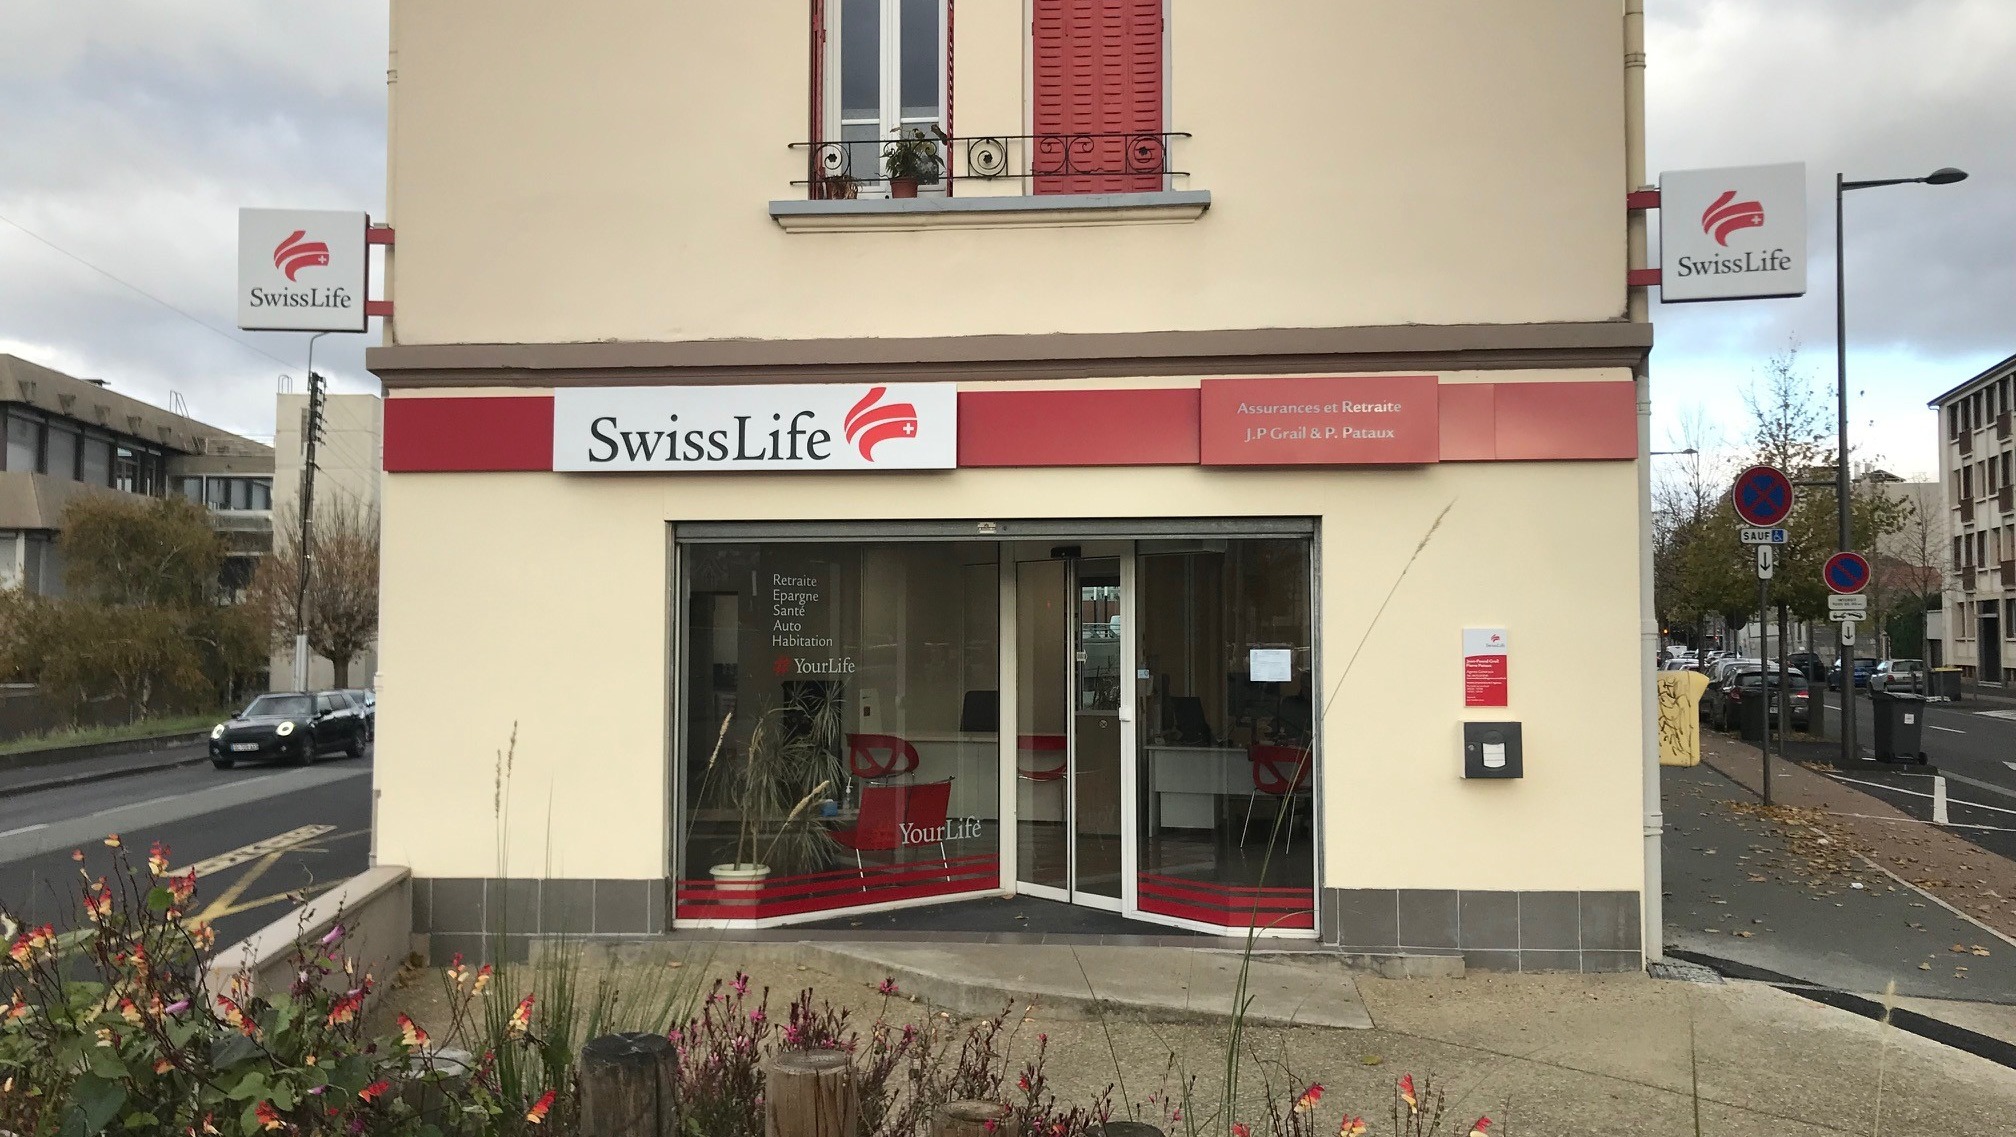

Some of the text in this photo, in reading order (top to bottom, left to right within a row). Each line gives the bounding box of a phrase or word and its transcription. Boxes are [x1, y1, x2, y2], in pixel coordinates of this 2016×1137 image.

[1677, 248, 1792, 277] SwissLife
[249, 286, 352, 308] SwissLife
[1237, 399, 1402, 414] Assurances et Retraite
[588, 410, 832, 463] SwissLife
[1244, 426, 1395, 443] J.P Grail & P. Pataux
[1743, 531, 1771, 541] SAUF
[773, 573, 818, 587] Retraite
[773, 589, 819, 605] Epargne
[773, 604, 806, 617] Santé
[773, 619, 802, 632] Auto
[772, 634, 833, 647] Habitation
[898, 815, 982, 845] YourLife
